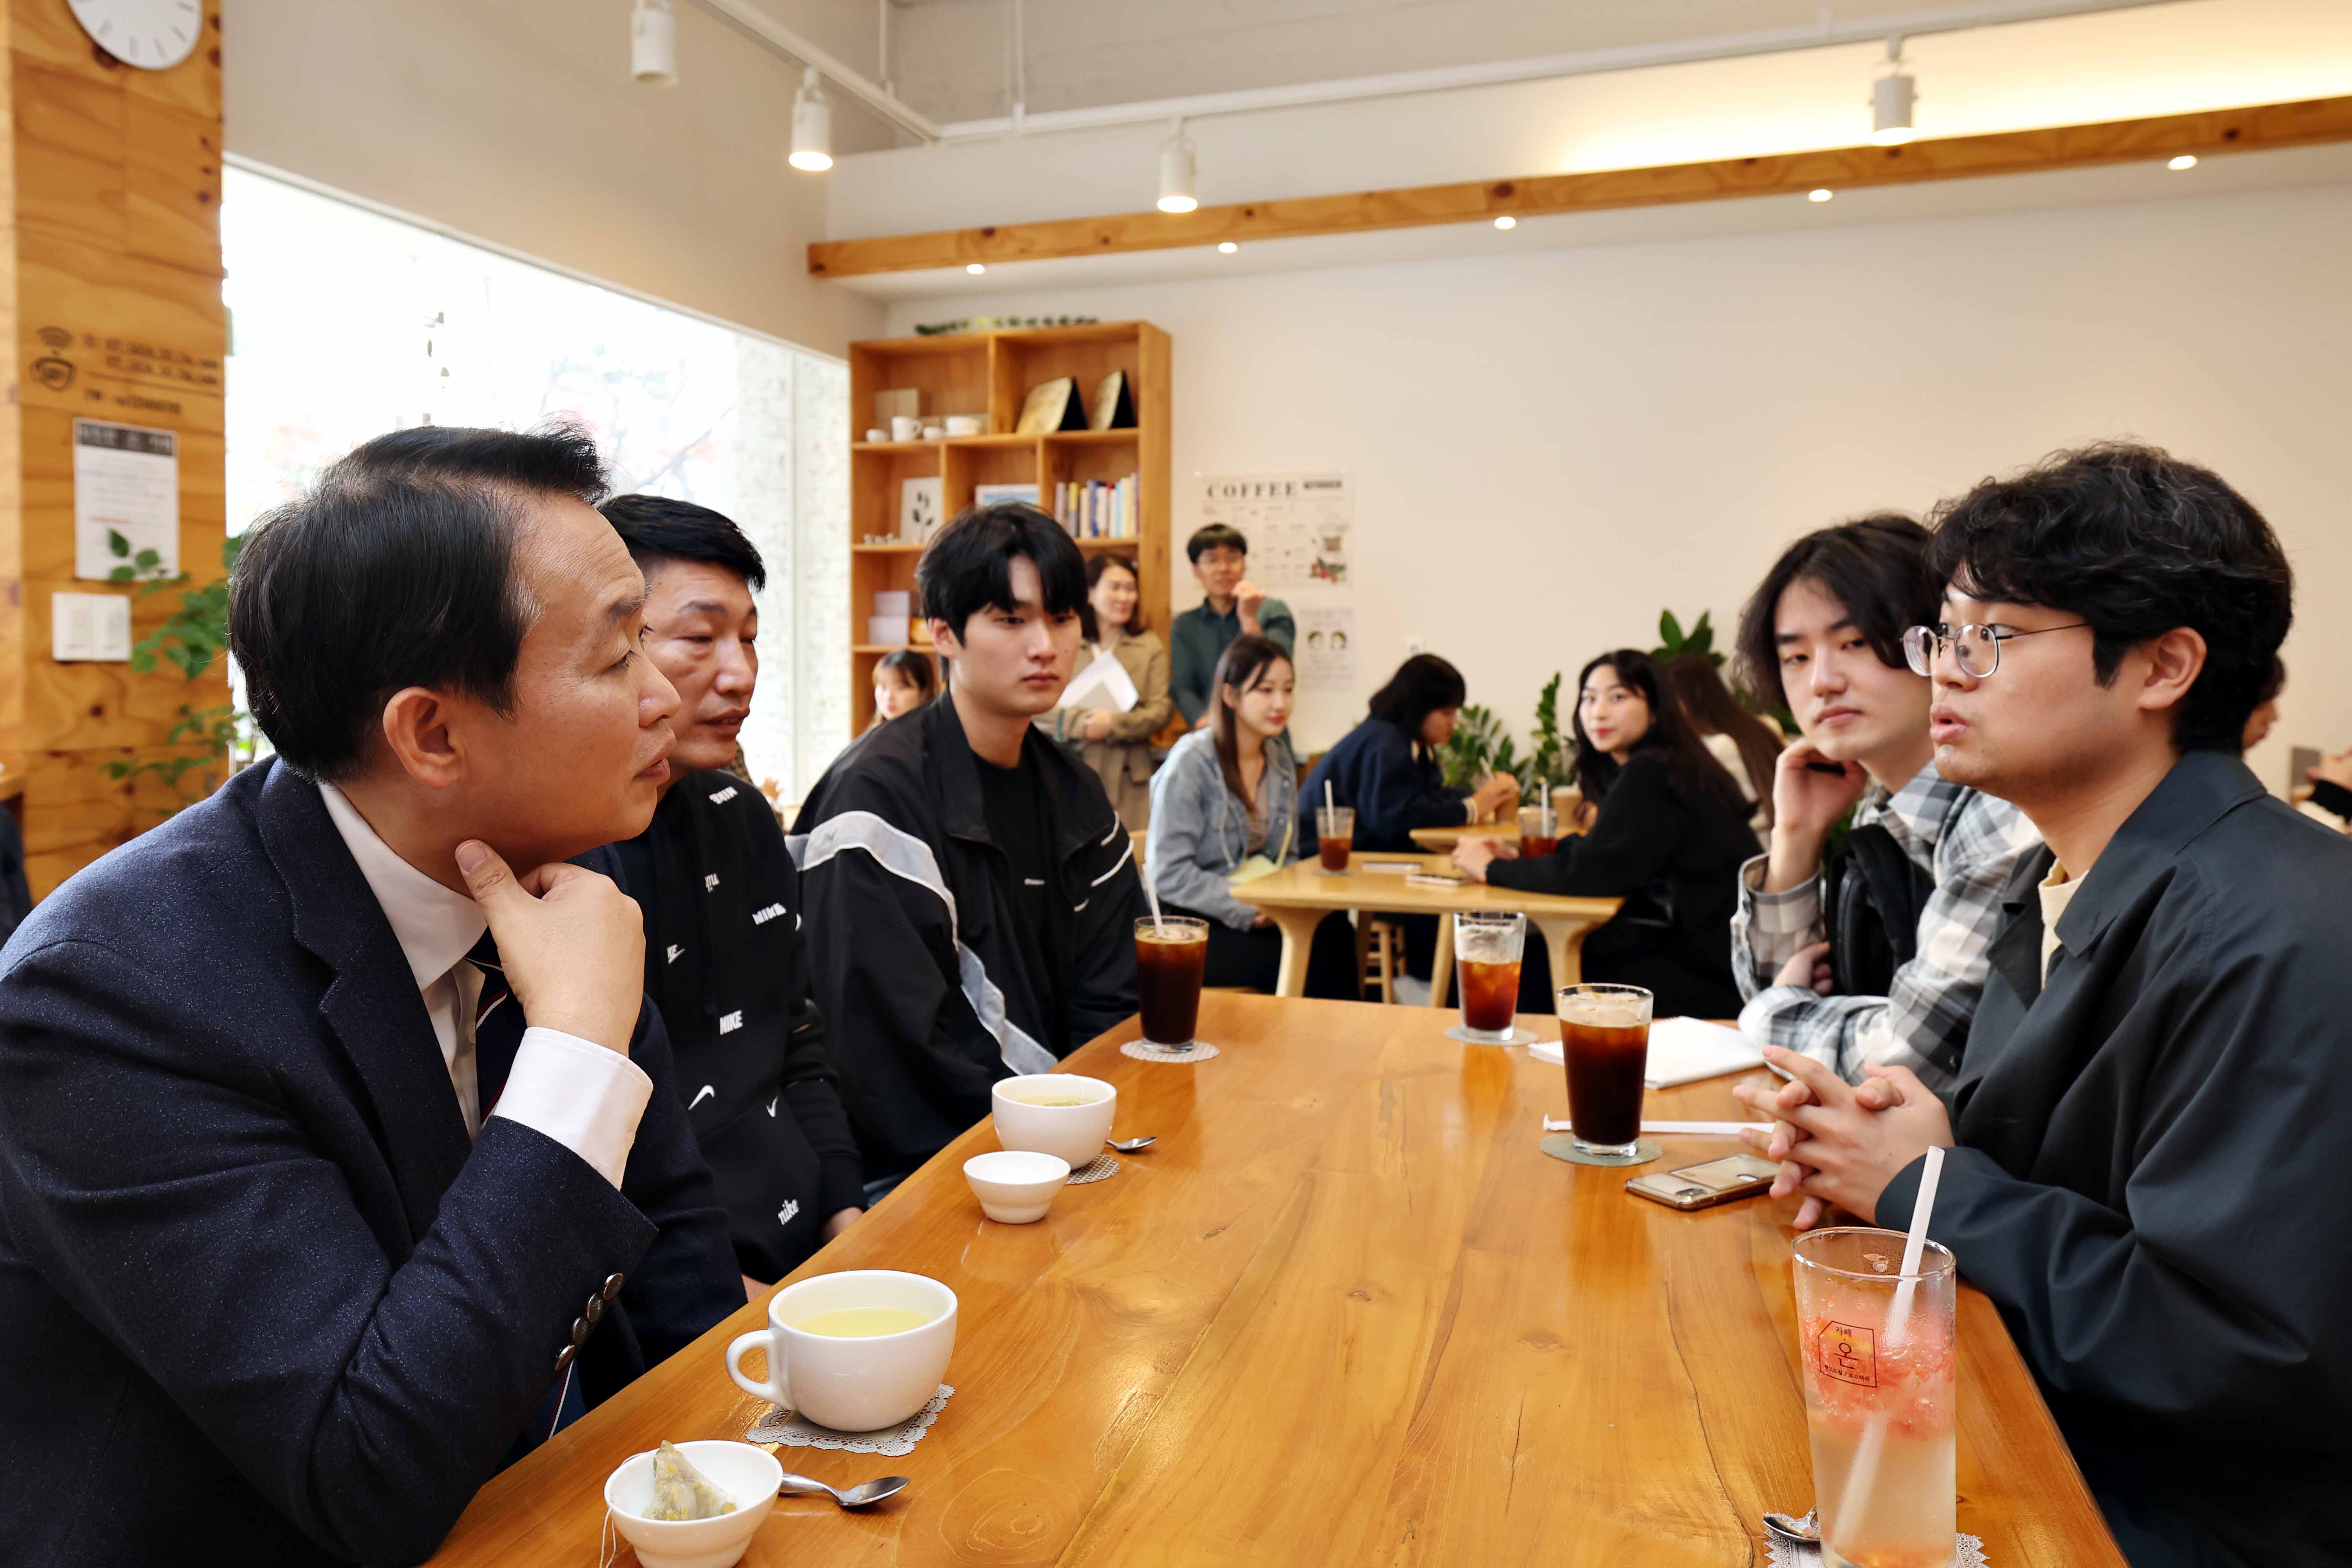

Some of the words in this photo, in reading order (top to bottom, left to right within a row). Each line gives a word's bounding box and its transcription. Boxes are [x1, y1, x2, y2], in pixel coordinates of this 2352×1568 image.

[1207, 481, 1298, 498] COFFEE
[752, 902, 787, 925] NIKE
[719, 1010, 743, 1035] NIKE
[778, 1199, 800, 1225] nike
[1835, 1326, 1852, 1338] 카페
[1833, 1342, 1859, 1369] 온
